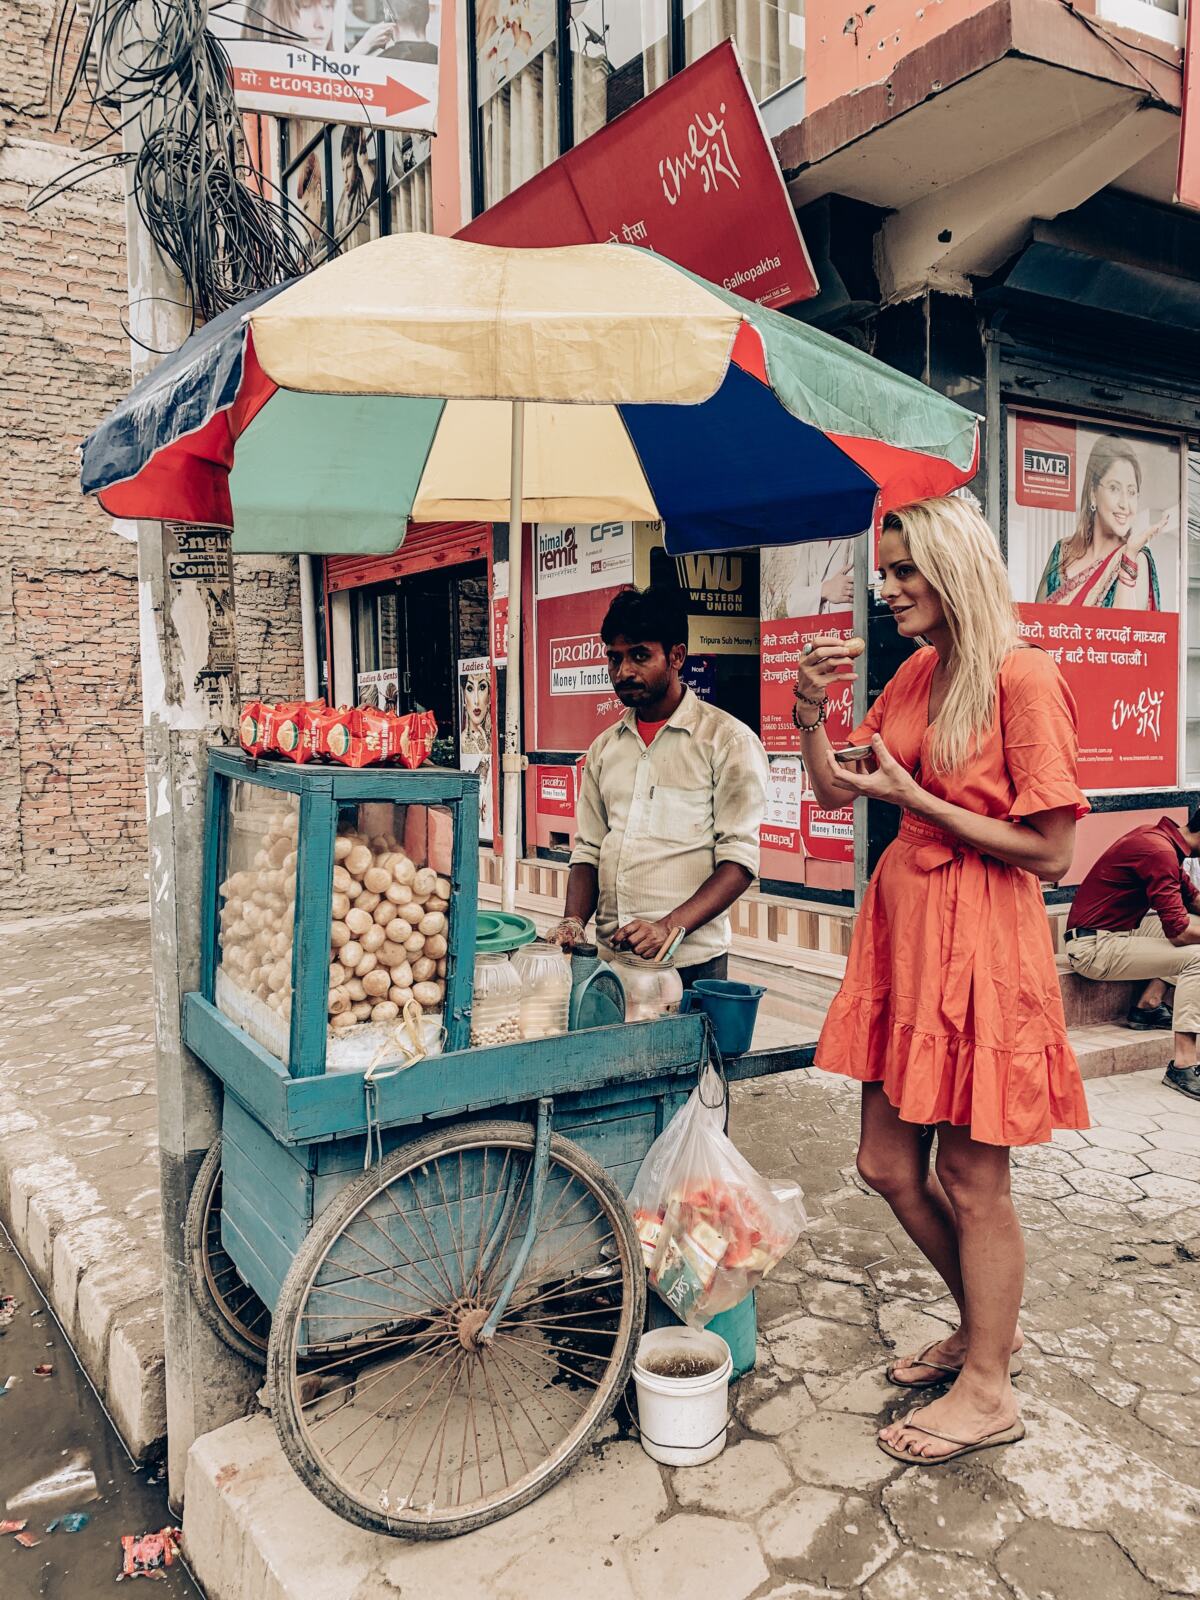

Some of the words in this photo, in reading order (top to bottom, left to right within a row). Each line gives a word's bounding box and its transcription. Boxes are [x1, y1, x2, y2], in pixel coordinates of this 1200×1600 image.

[286, 53, 307, 69] 1st
[311, 55, 361, 77] Floor
[622, 220, 648, 245] पैसा
[723, 255, 782, 292] Galkopakha
[1032, 456, 1066, 476] IME
[539, 530, 563, 552] himal
[539, 543, 578, 572] remit
[690, 592, 742, 602] WESTERN
[707, 601, 742, 612] UNION
[1048, 623, 1083, 640] छरितो
[1085, 627, 1093, 640] र
[700, 636, 720, 646] Tripura
[734, 637, 753, 647] Money
[1087, 647, 1108, 664] पैसा
[462, 661, 484, 672] Ladies
[359, 674, 376, 683] Ladies
[383, 671, 398, 681] Gents
[553, 673, 577, 689] Money
[812, 824, 829, 835] Money
